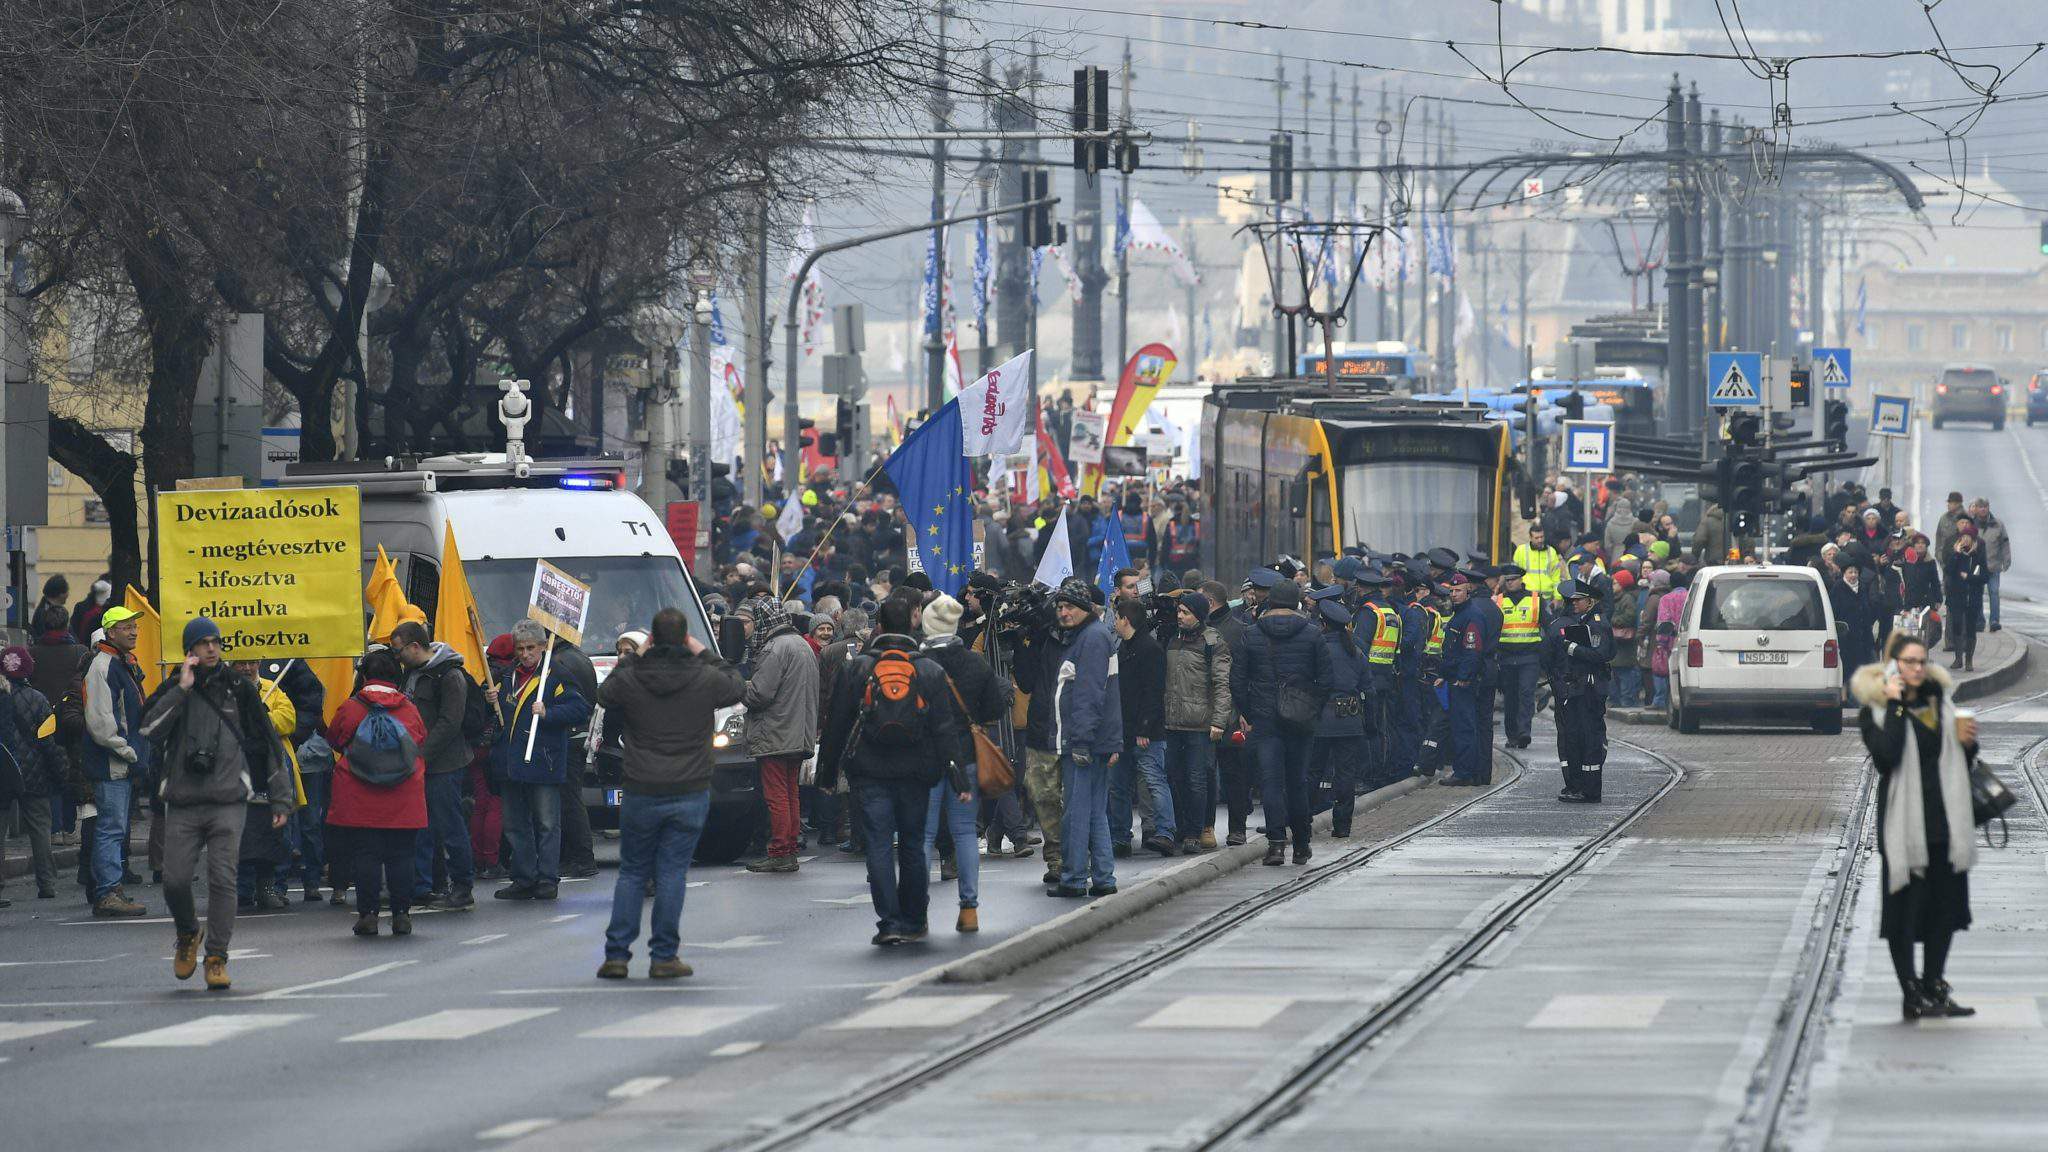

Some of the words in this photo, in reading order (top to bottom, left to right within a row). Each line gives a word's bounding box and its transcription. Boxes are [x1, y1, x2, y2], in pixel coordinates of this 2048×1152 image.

[176, 498, 340, 522] Devizaadósok
[622, 521, 652, 536] T1
[202, 539, 347, 561] megtévesztve
[198, 570, 296, 588] kifosztva
[199, 599, 288, 618] elárulva
[220, 630, 311, 652] gfosztva
